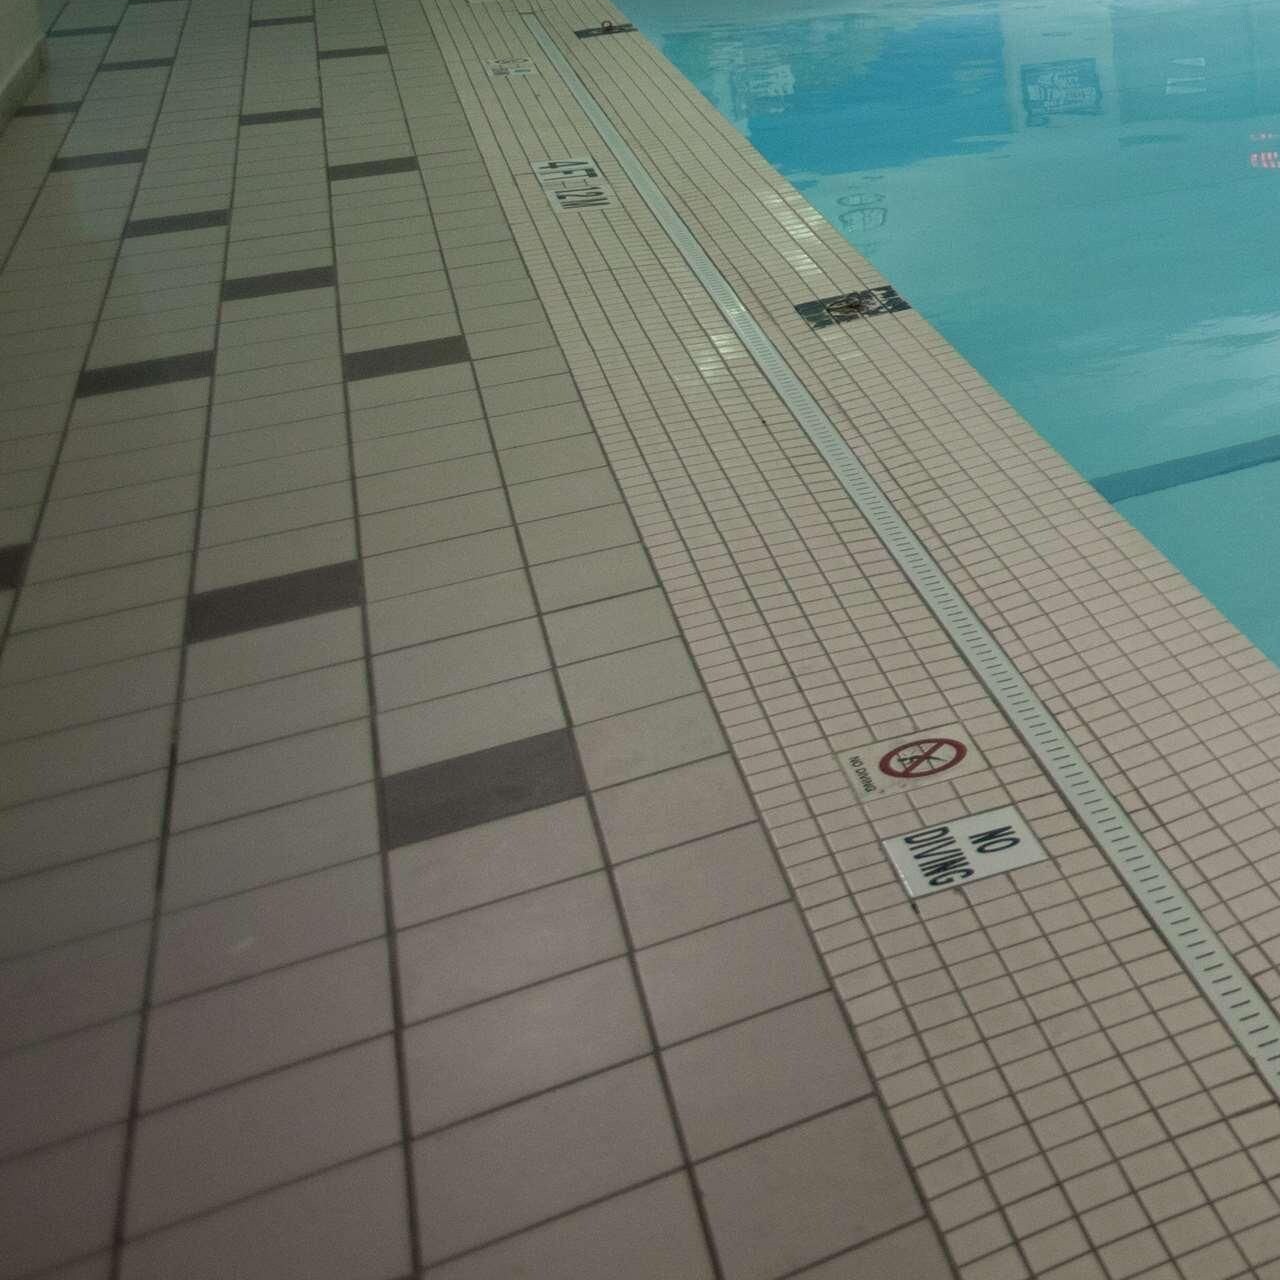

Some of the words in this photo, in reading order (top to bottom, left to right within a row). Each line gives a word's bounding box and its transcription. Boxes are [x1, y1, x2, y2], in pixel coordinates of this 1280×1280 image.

[849, 755, 864, 768] NO
[855, 767, 877, 793] DIVING
[968, 825, 1021, 854] NO
[904, 826, 975, 886] DIVING
